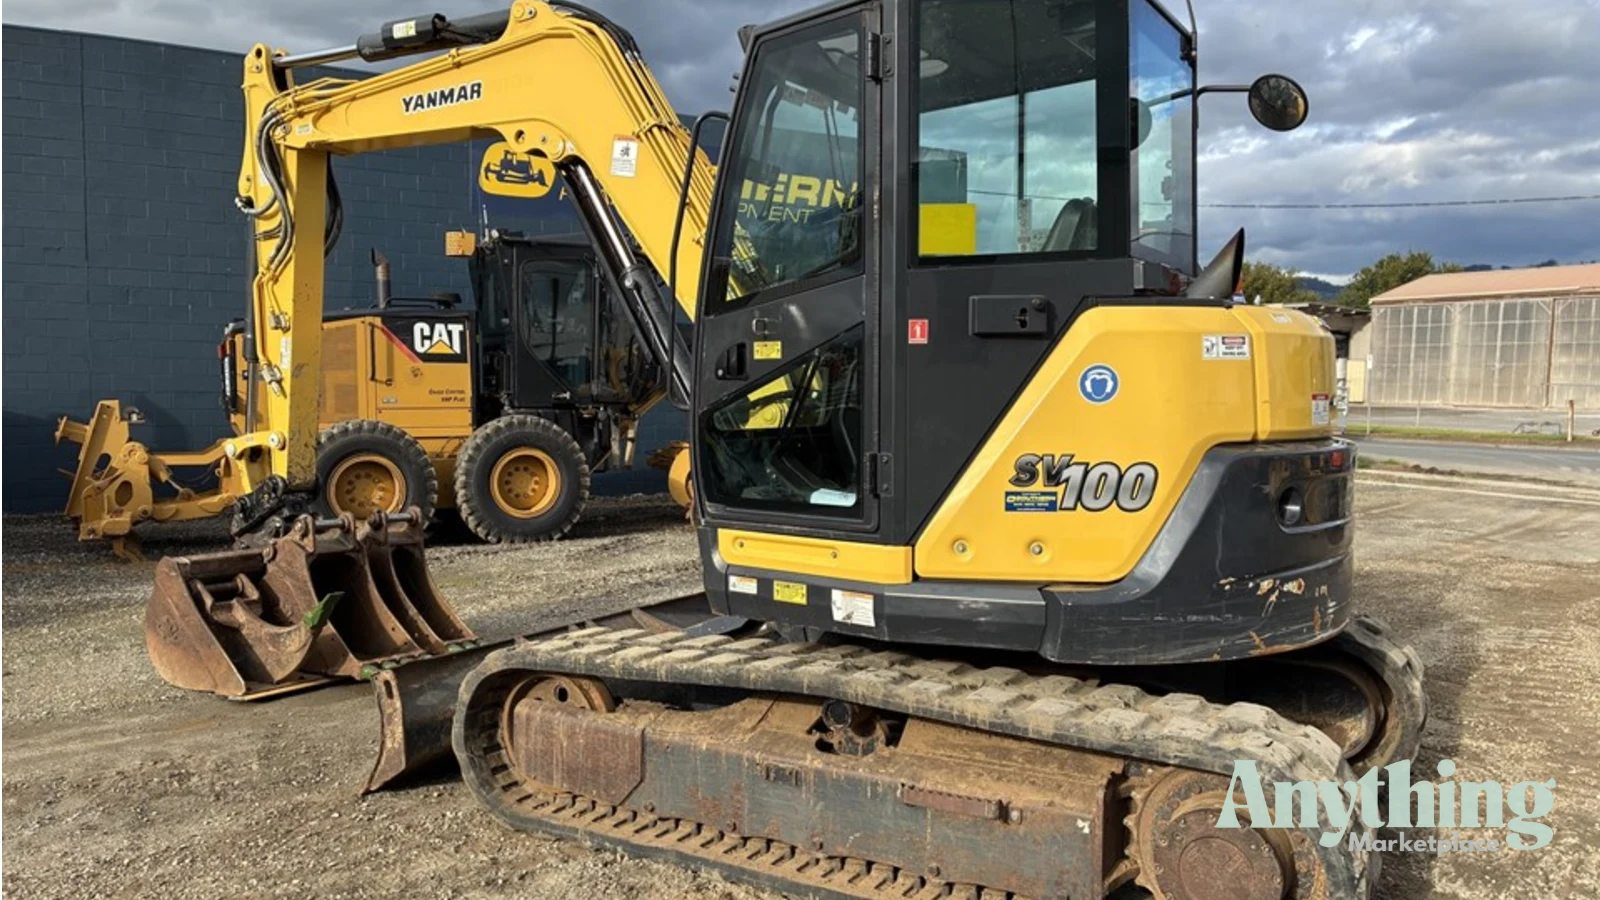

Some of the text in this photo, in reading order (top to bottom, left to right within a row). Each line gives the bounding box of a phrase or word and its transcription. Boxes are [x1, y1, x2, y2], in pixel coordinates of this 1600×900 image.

[401, 81, 483, 113] YANMAR
[412, 321, 465, 355] CAT
[1008, 453, 1159, 512] SV100
